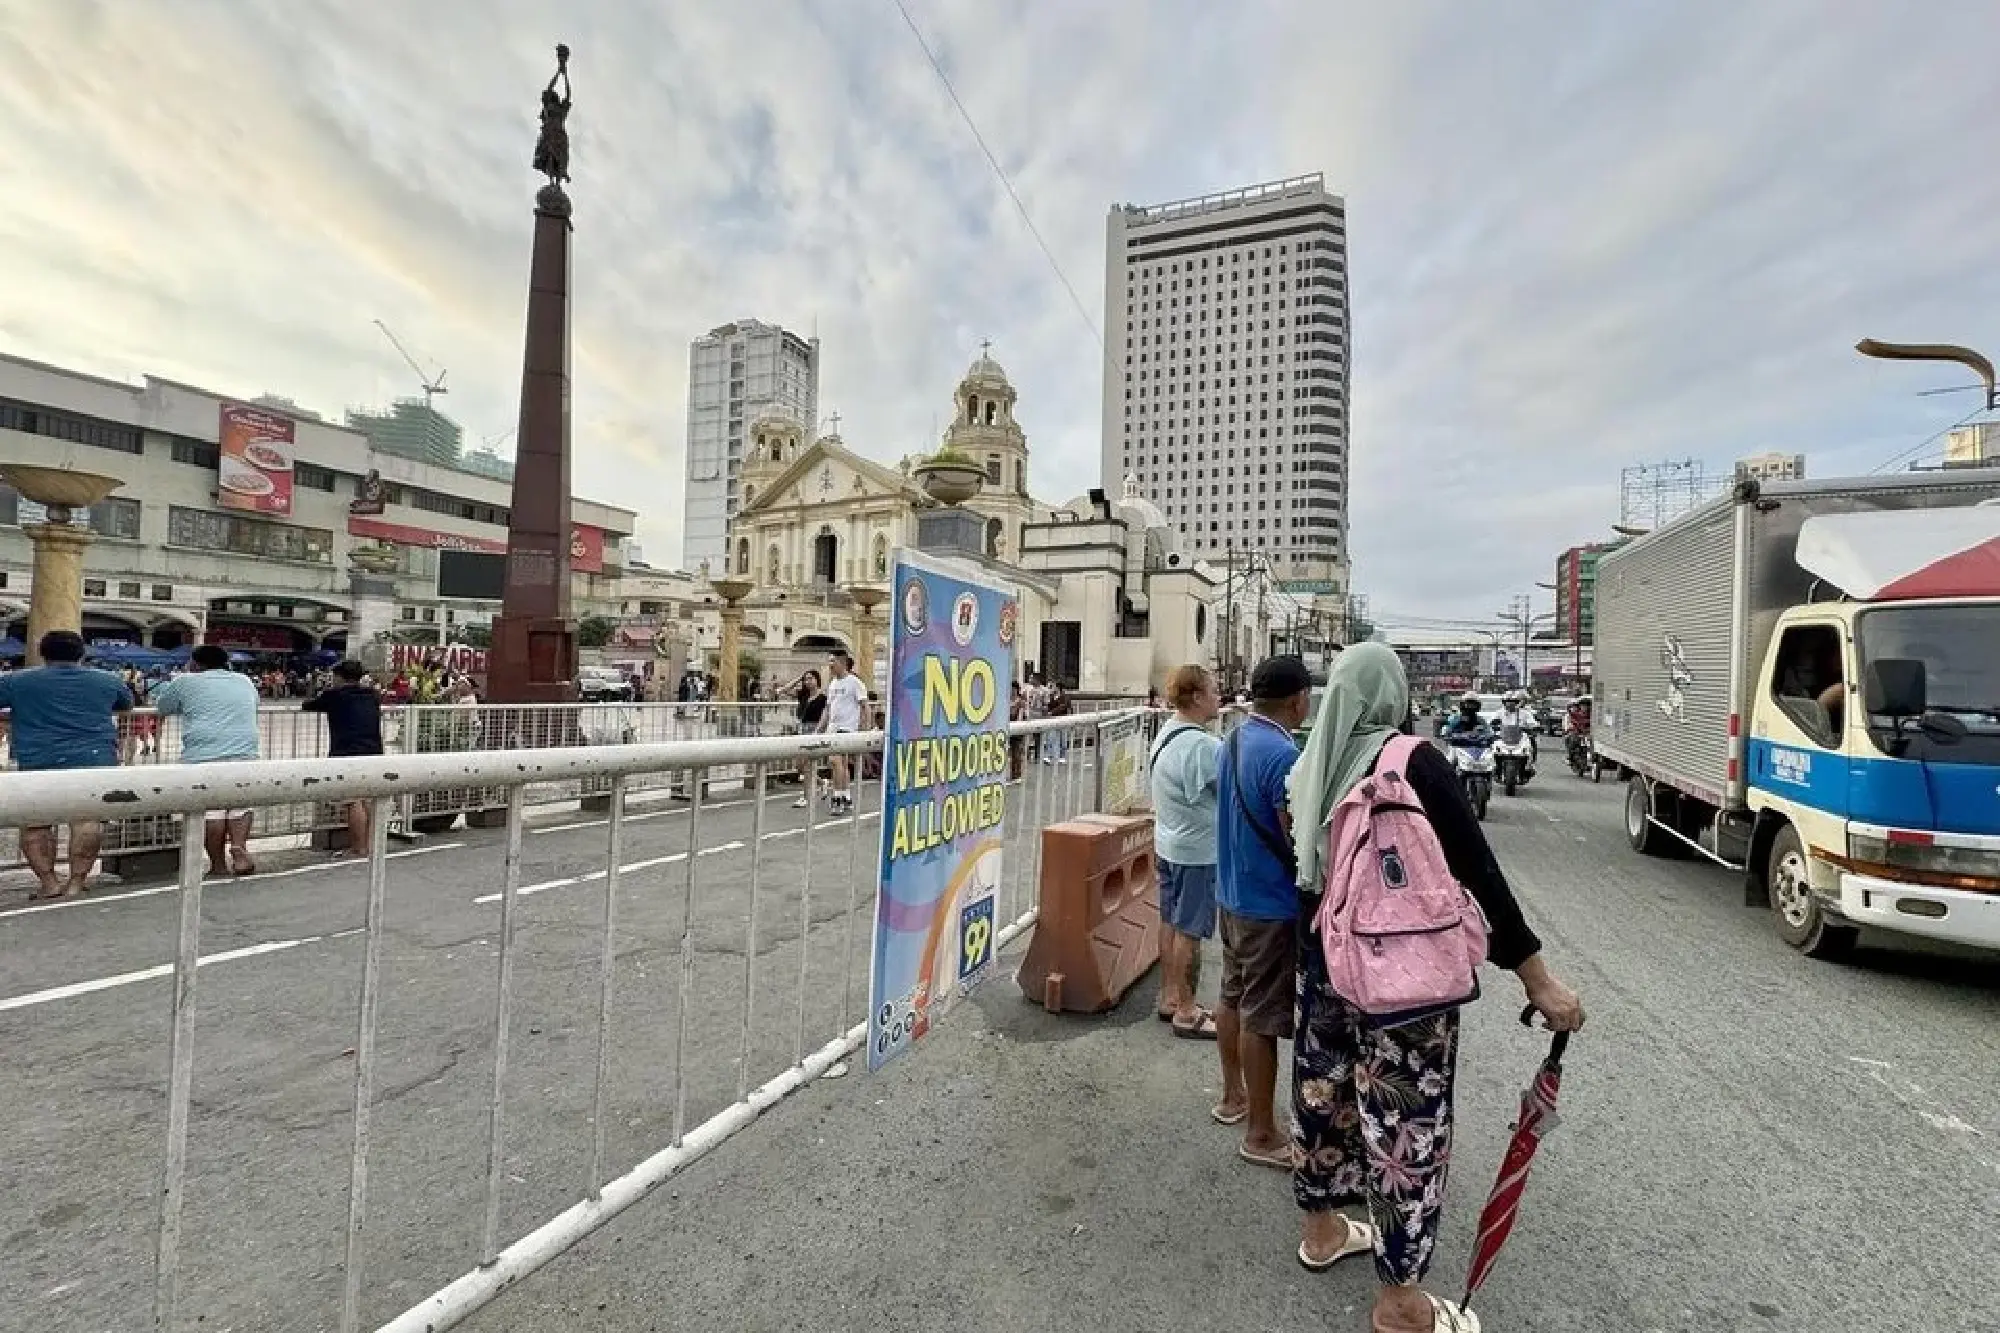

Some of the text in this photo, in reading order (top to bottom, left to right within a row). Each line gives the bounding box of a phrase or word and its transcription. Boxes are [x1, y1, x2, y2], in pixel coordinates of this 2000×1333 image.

[921, 654, 996, 727] NO
[896, 730, 1007, 793] VENDORS
[890, 783, 1004, 860] ALLOWED
